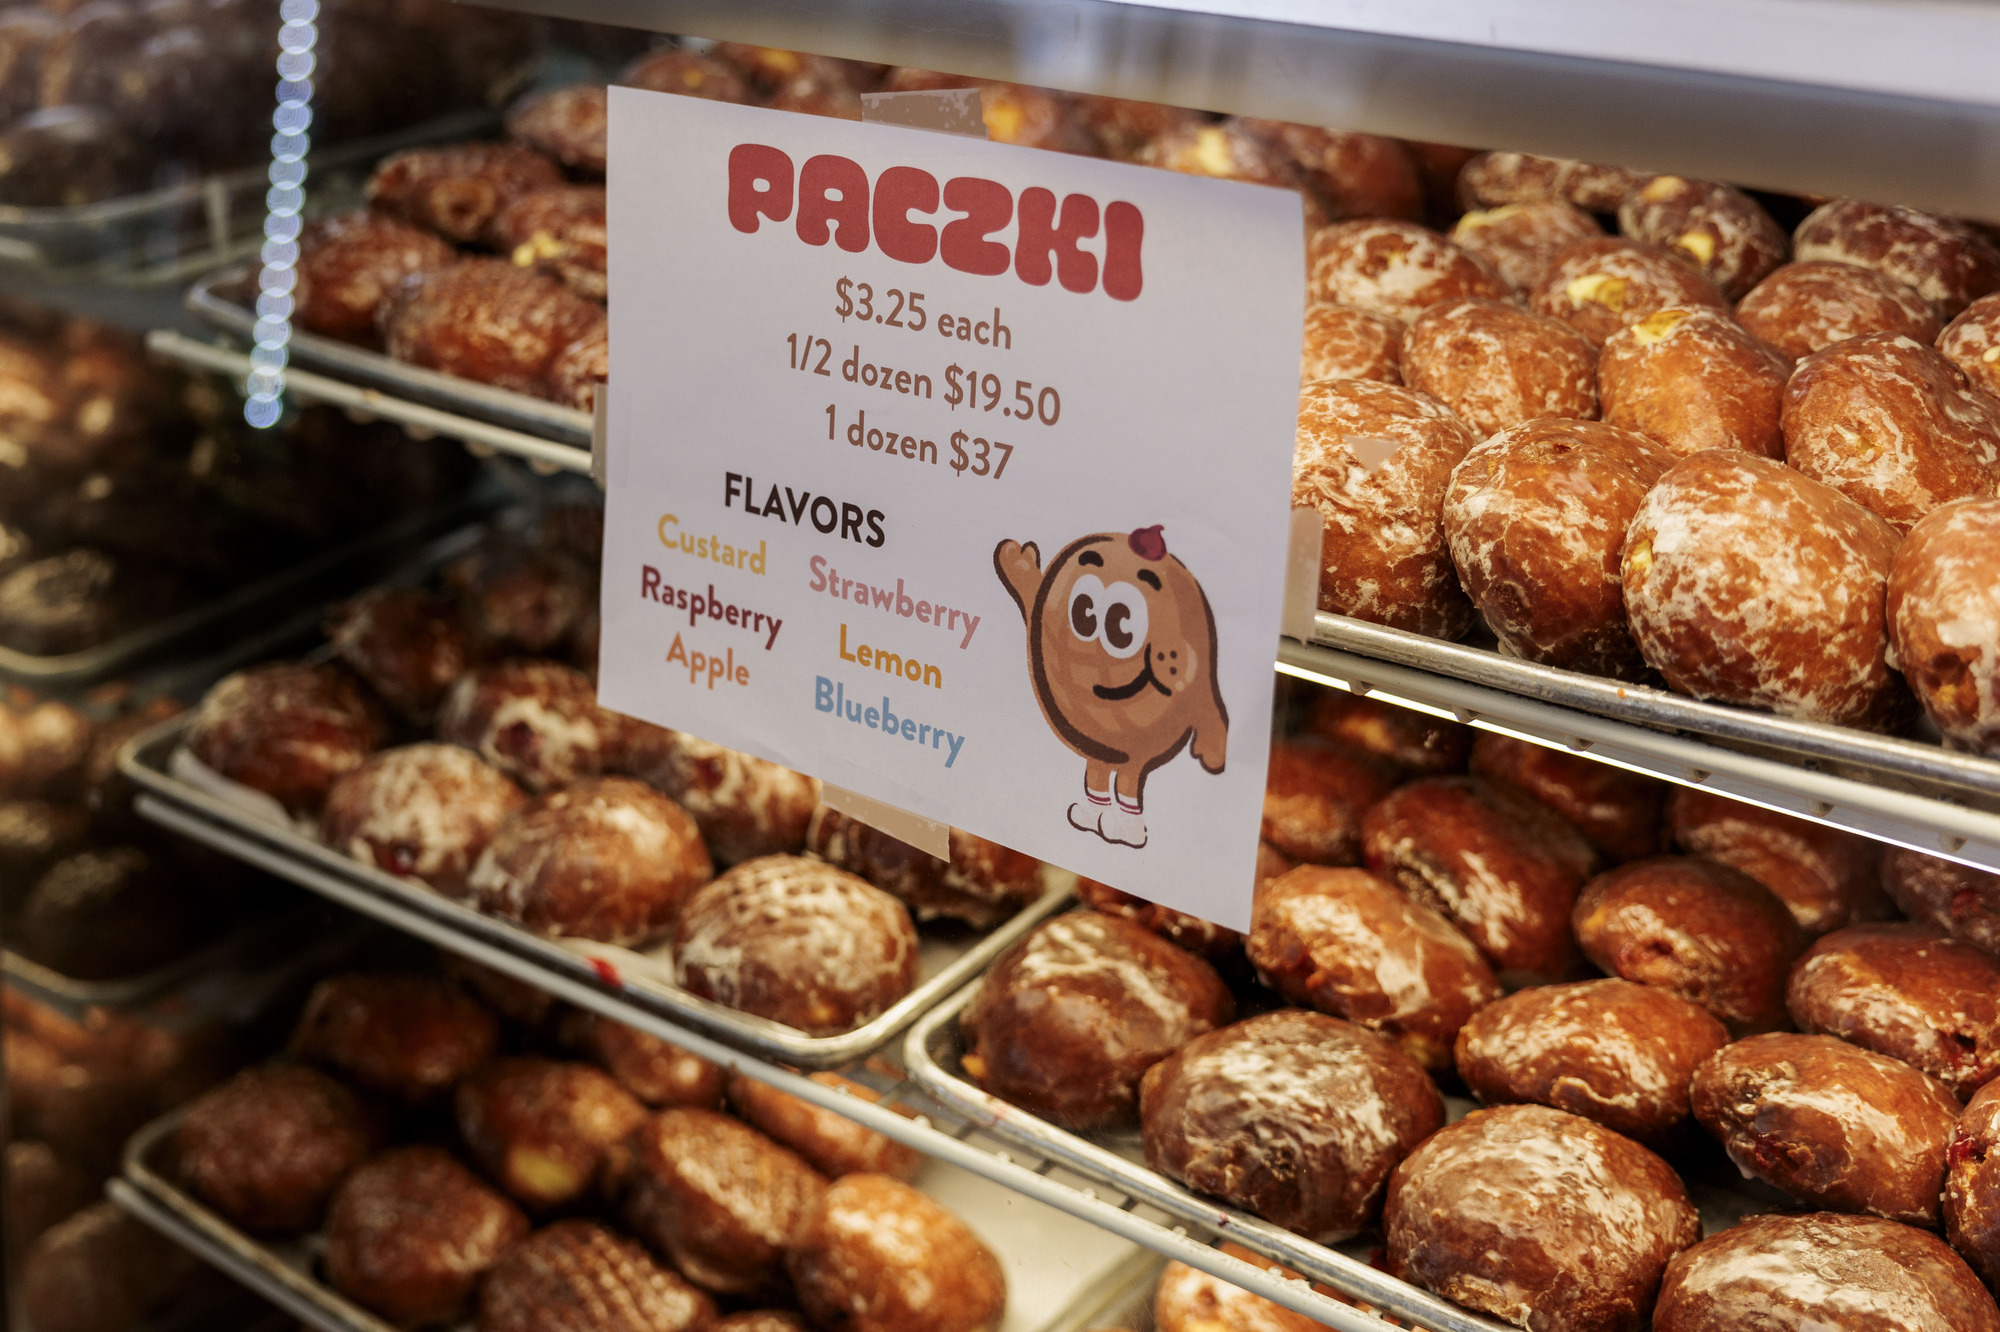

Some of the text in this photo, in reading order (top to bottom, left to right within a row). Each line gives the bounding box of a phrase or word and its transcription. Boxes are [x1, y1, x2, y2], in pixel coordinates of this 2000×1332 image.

[728, 143, 1144, 302] PACZKI
[835, 275, 1012, 350] $3.25 each
[786, 333, 1061, 426] 1/2 dozen $19.50
[825, 404, 1014, 480] 1 dozen $37
[657, 513, 767, 576] Custard
[724, 471, 886, 548] FLAVORS
[641, 564, 783, 651] Raspberry
[808, 555, 981, 650] Strawberry
[665, 631, 750, 690] Apple
[839, 623, 943, 689] Lemon
[814, 675, 965, 769] Blueberry
